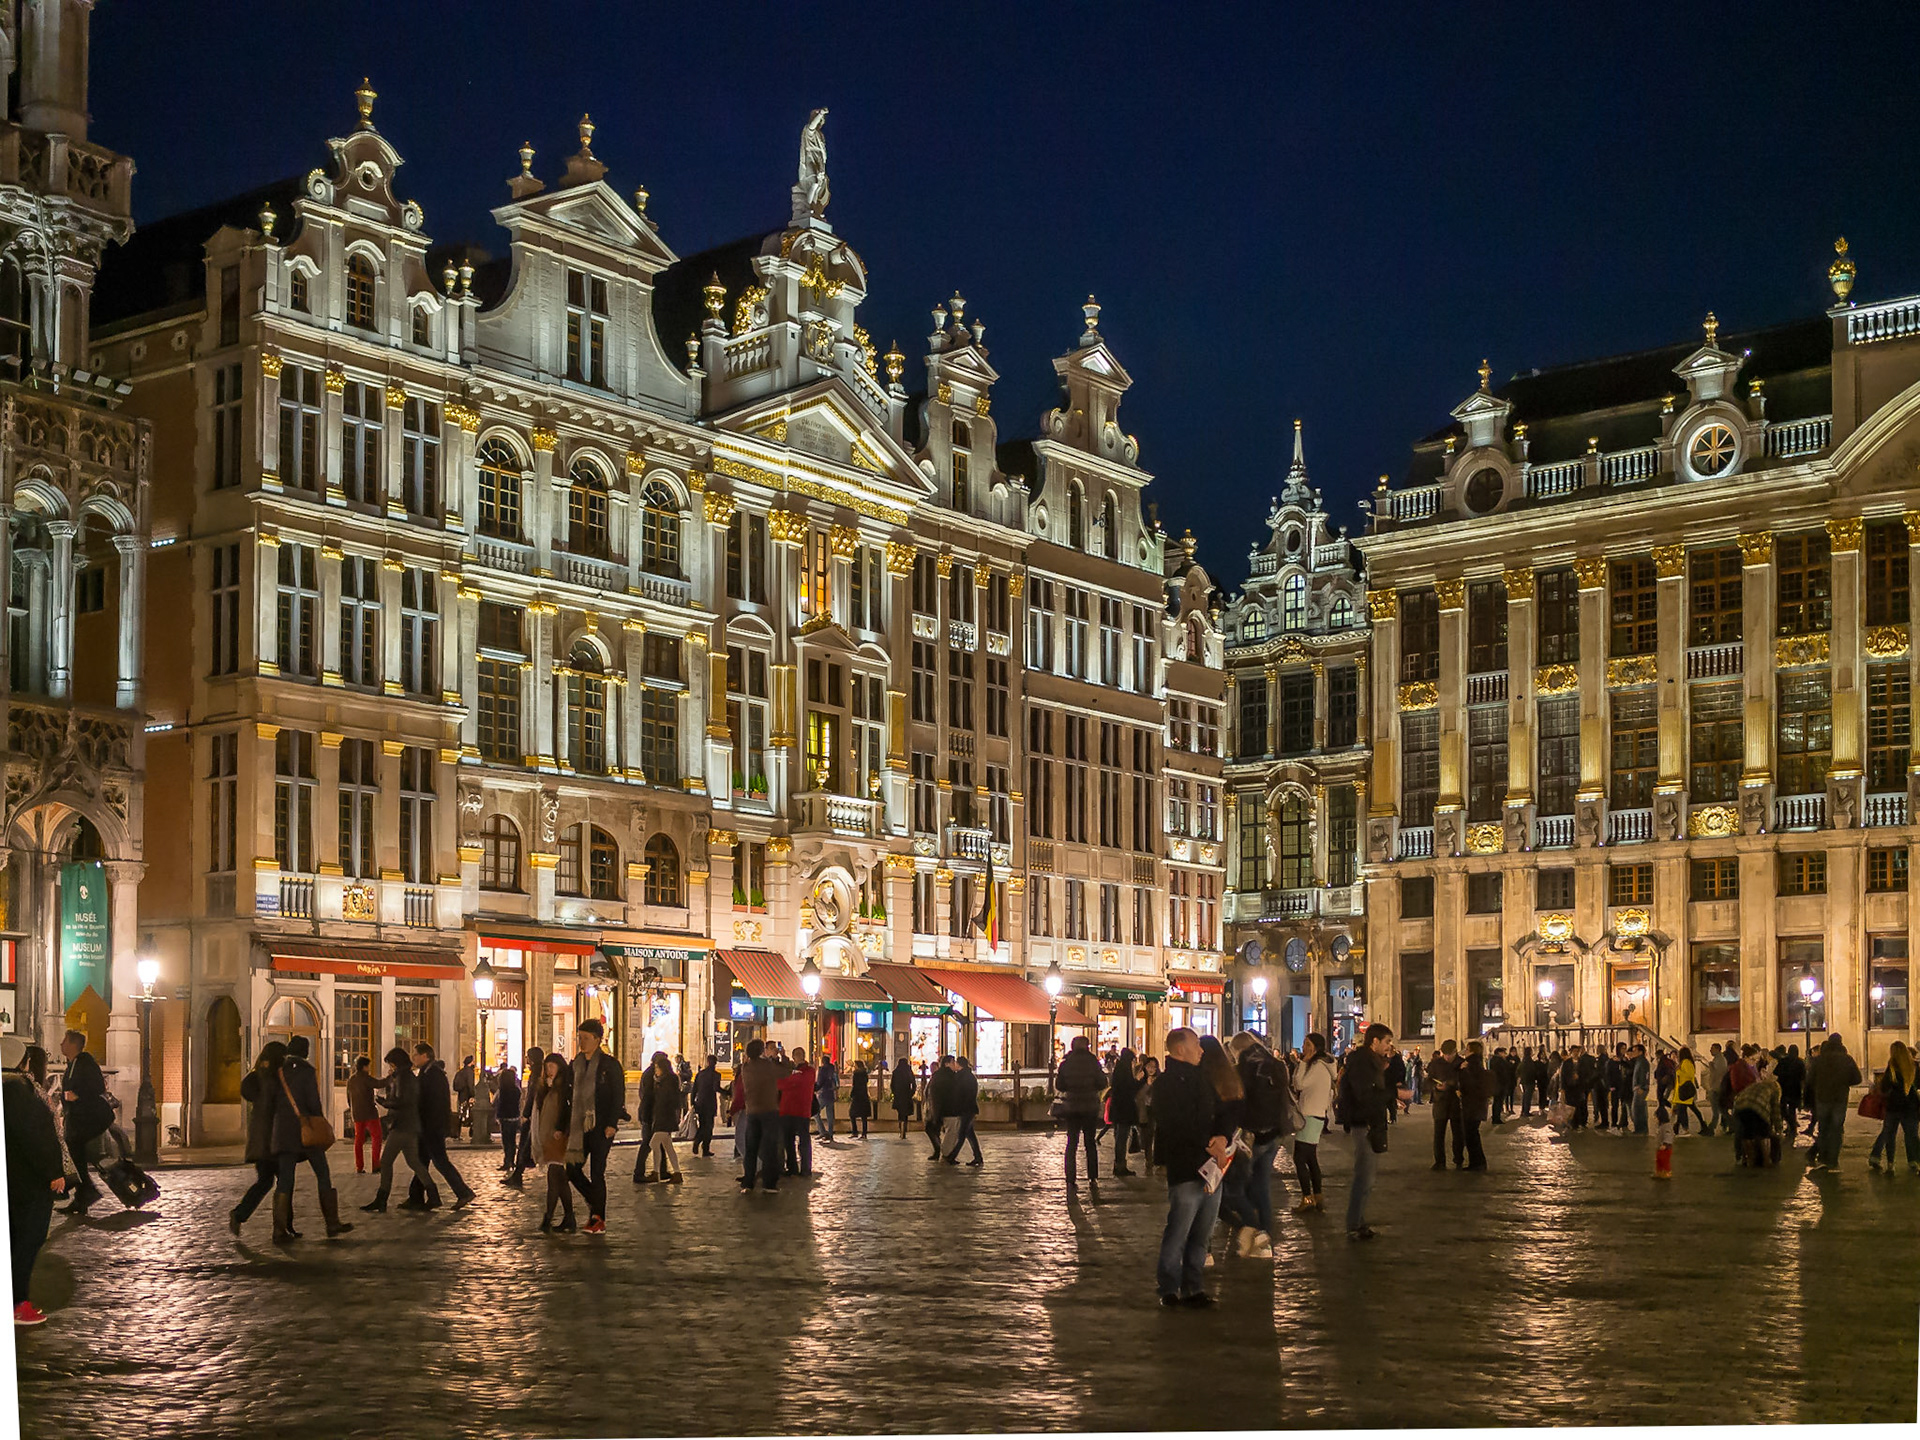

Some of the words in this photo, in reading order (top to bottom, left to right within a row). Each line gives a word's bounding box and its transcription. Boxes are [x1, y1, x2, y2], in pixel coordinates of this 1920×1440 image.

[72, 942, 102, 952] MUSEUM
[624, 947, 654, 958] MAISON
[654, 949, 689, 960] ANTOINE
[1128, 992, 1146, 1000] GODIVA
[1099, 999, 1124, 1010] GODIVA
